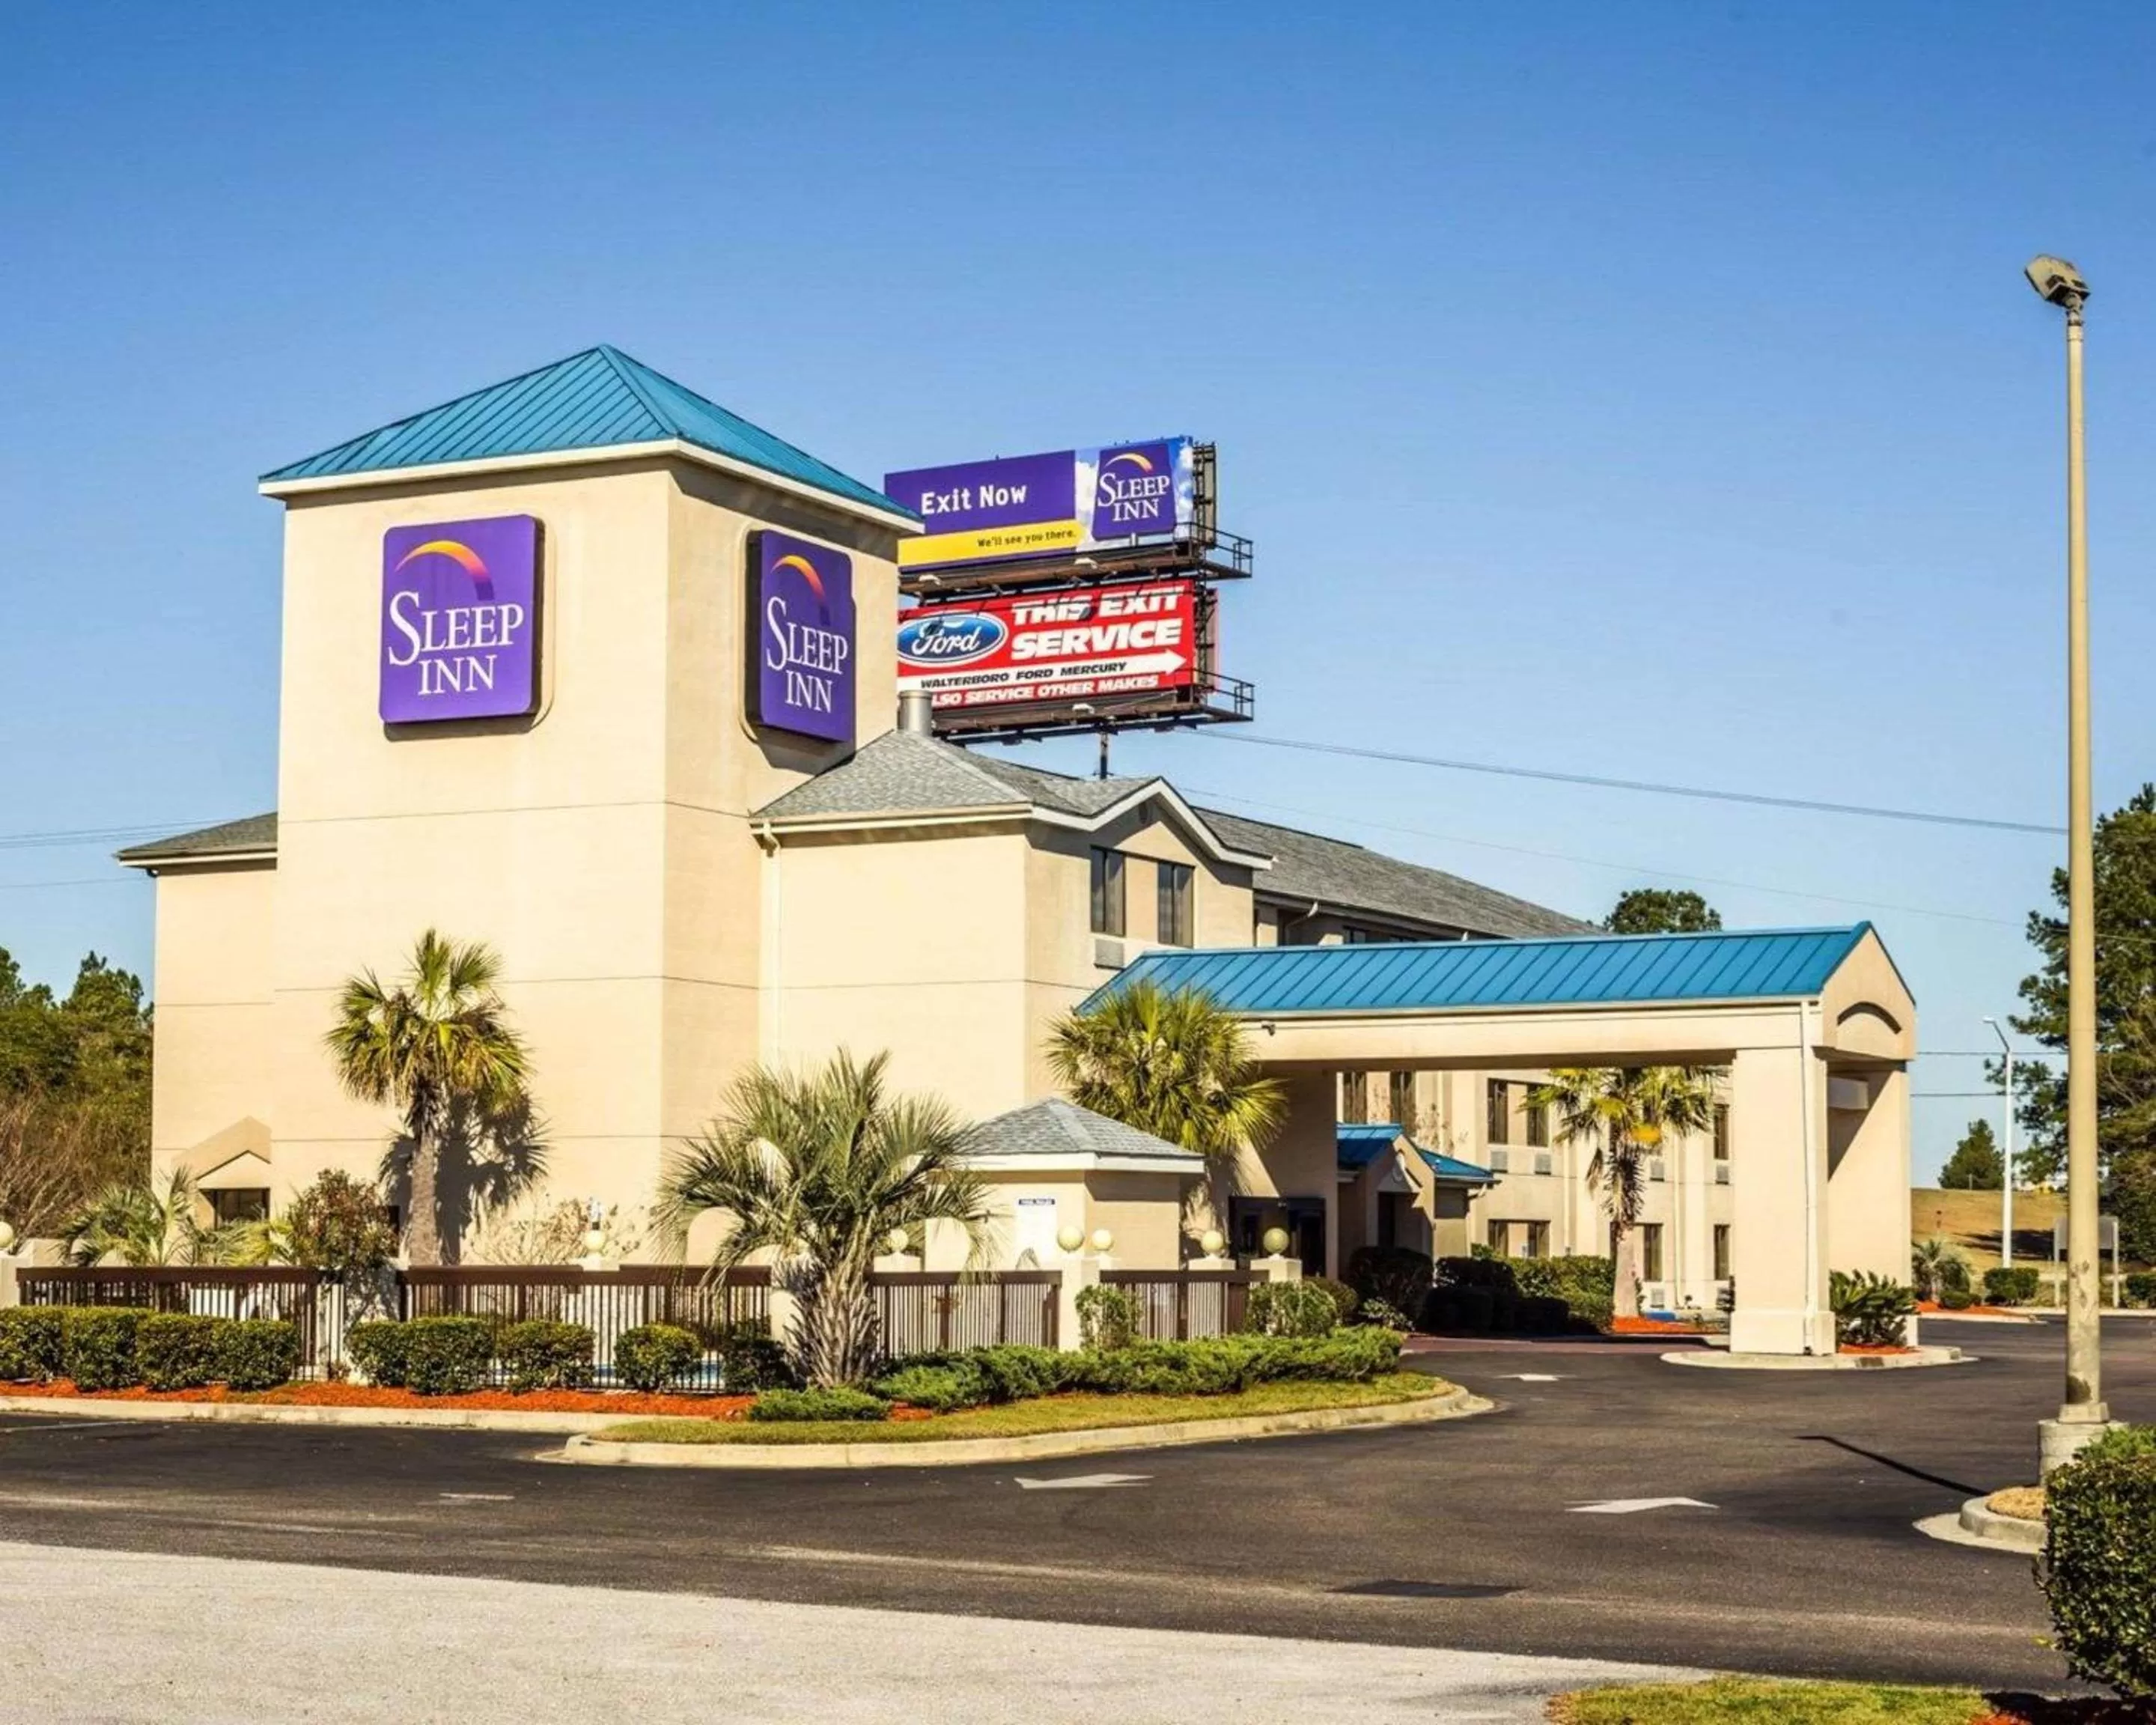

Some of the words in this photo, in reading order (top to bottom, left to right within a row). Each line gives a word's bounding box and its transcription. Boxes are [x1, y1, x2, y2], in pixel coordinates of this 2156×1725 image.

[921, 487, 972, 515] Exit
[979, 484, 1027, 508] Now
[1097, 472, 1170, 507] SLEEP
[1112, 498, 1159, 521] INN
[977, 536, 1002, 547] We'll
[1005, 535, 1022, 545] see
[1025, 533, 1044, 544] you
[1045, 530, 1076, 541] there.
[1011, 595, 1094, 626] THIS
[1098, 585, 1185, 617] EXIT
[389, 591, 524, 666] SLEEP
[767, 596, 848, 675] SLEEP
[911, 620, 982, 655] Ford
[1011, 618, 1183, 660] SERVICE
[418, 654, 497, 696] INN
[785, 669, 832, 713] INN
[921, 672, 1009, 688] WALTERBORO
[1016, 669, 1053, 681] FORD
[1060, 662, 1127, 677] MERCURY
[931, 693, 962, 707] LSO
[965, 687, 1035, 705] SERVICE
[1038, 680, 1094, 698] OTHER
[1097, 675, 1158, 693] MAKES
